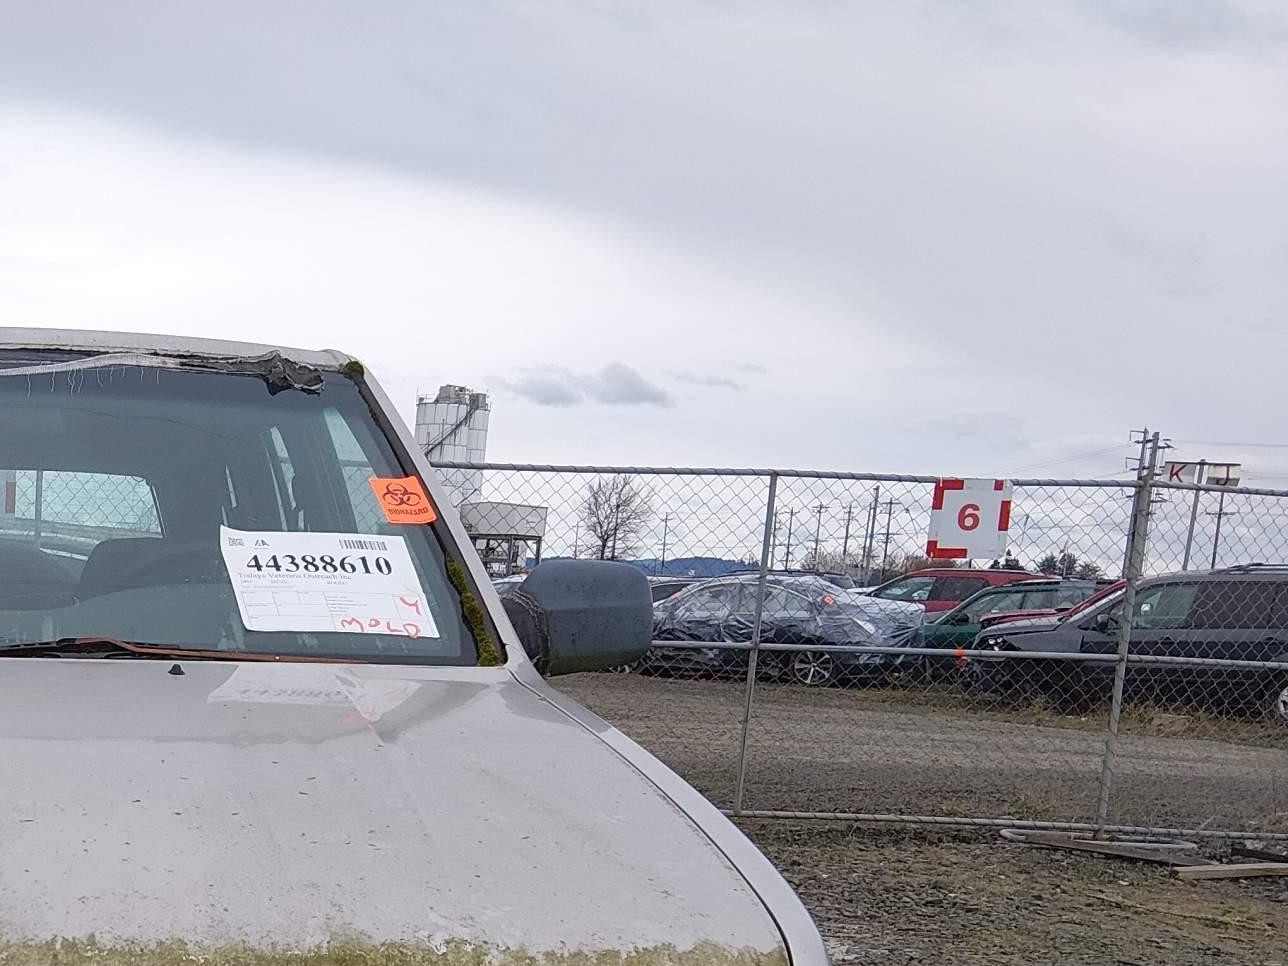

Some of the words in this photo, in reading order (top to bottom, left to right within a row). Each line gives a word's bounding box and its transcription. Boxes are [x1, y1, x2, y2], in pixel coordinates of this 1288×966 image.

[1168, 463, 1187, 483] K
[387, 507, 429, 515] BIOHAZARD
[957, 503, 981, 531] 6
[246, 553, 392, 576] 44388610
